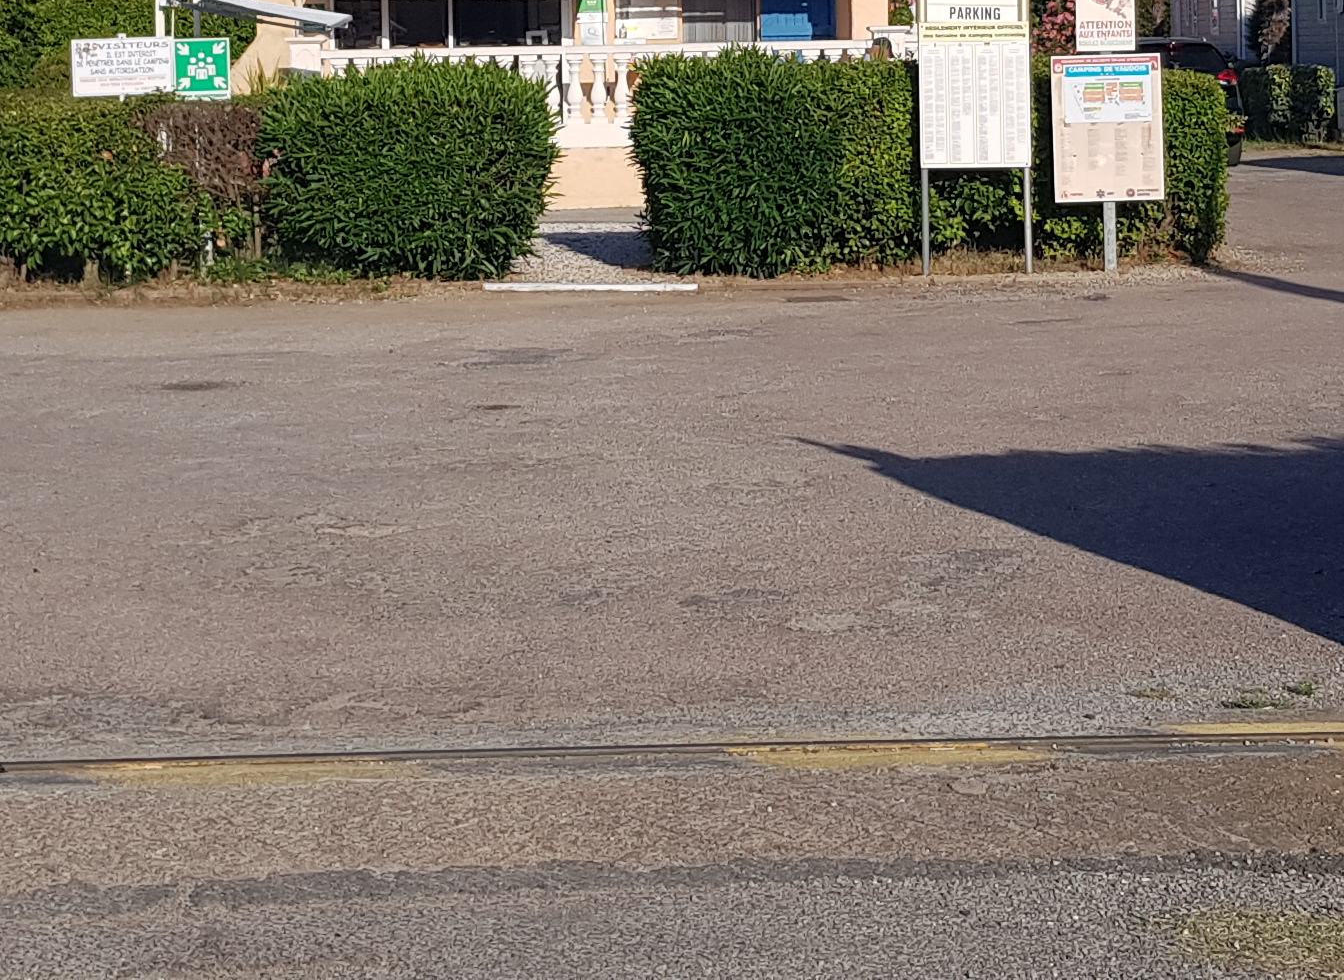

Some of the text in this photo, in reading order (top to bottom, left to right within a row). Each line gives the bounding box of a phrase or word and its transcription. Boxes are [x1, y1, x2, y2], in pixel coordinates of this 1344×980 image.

[949, 6, 1001, 21] PARKING
[1079, 20, 1132, 30] ATTENTION
[1078, 30, 1095, 39] AUX
[97, 41, 169, 50] VISITEURS
[114, 51, 125, 59] EST
[143, 57, 169, 65] CAMPING
[108, 66, 155, 75] AUTORISATION
